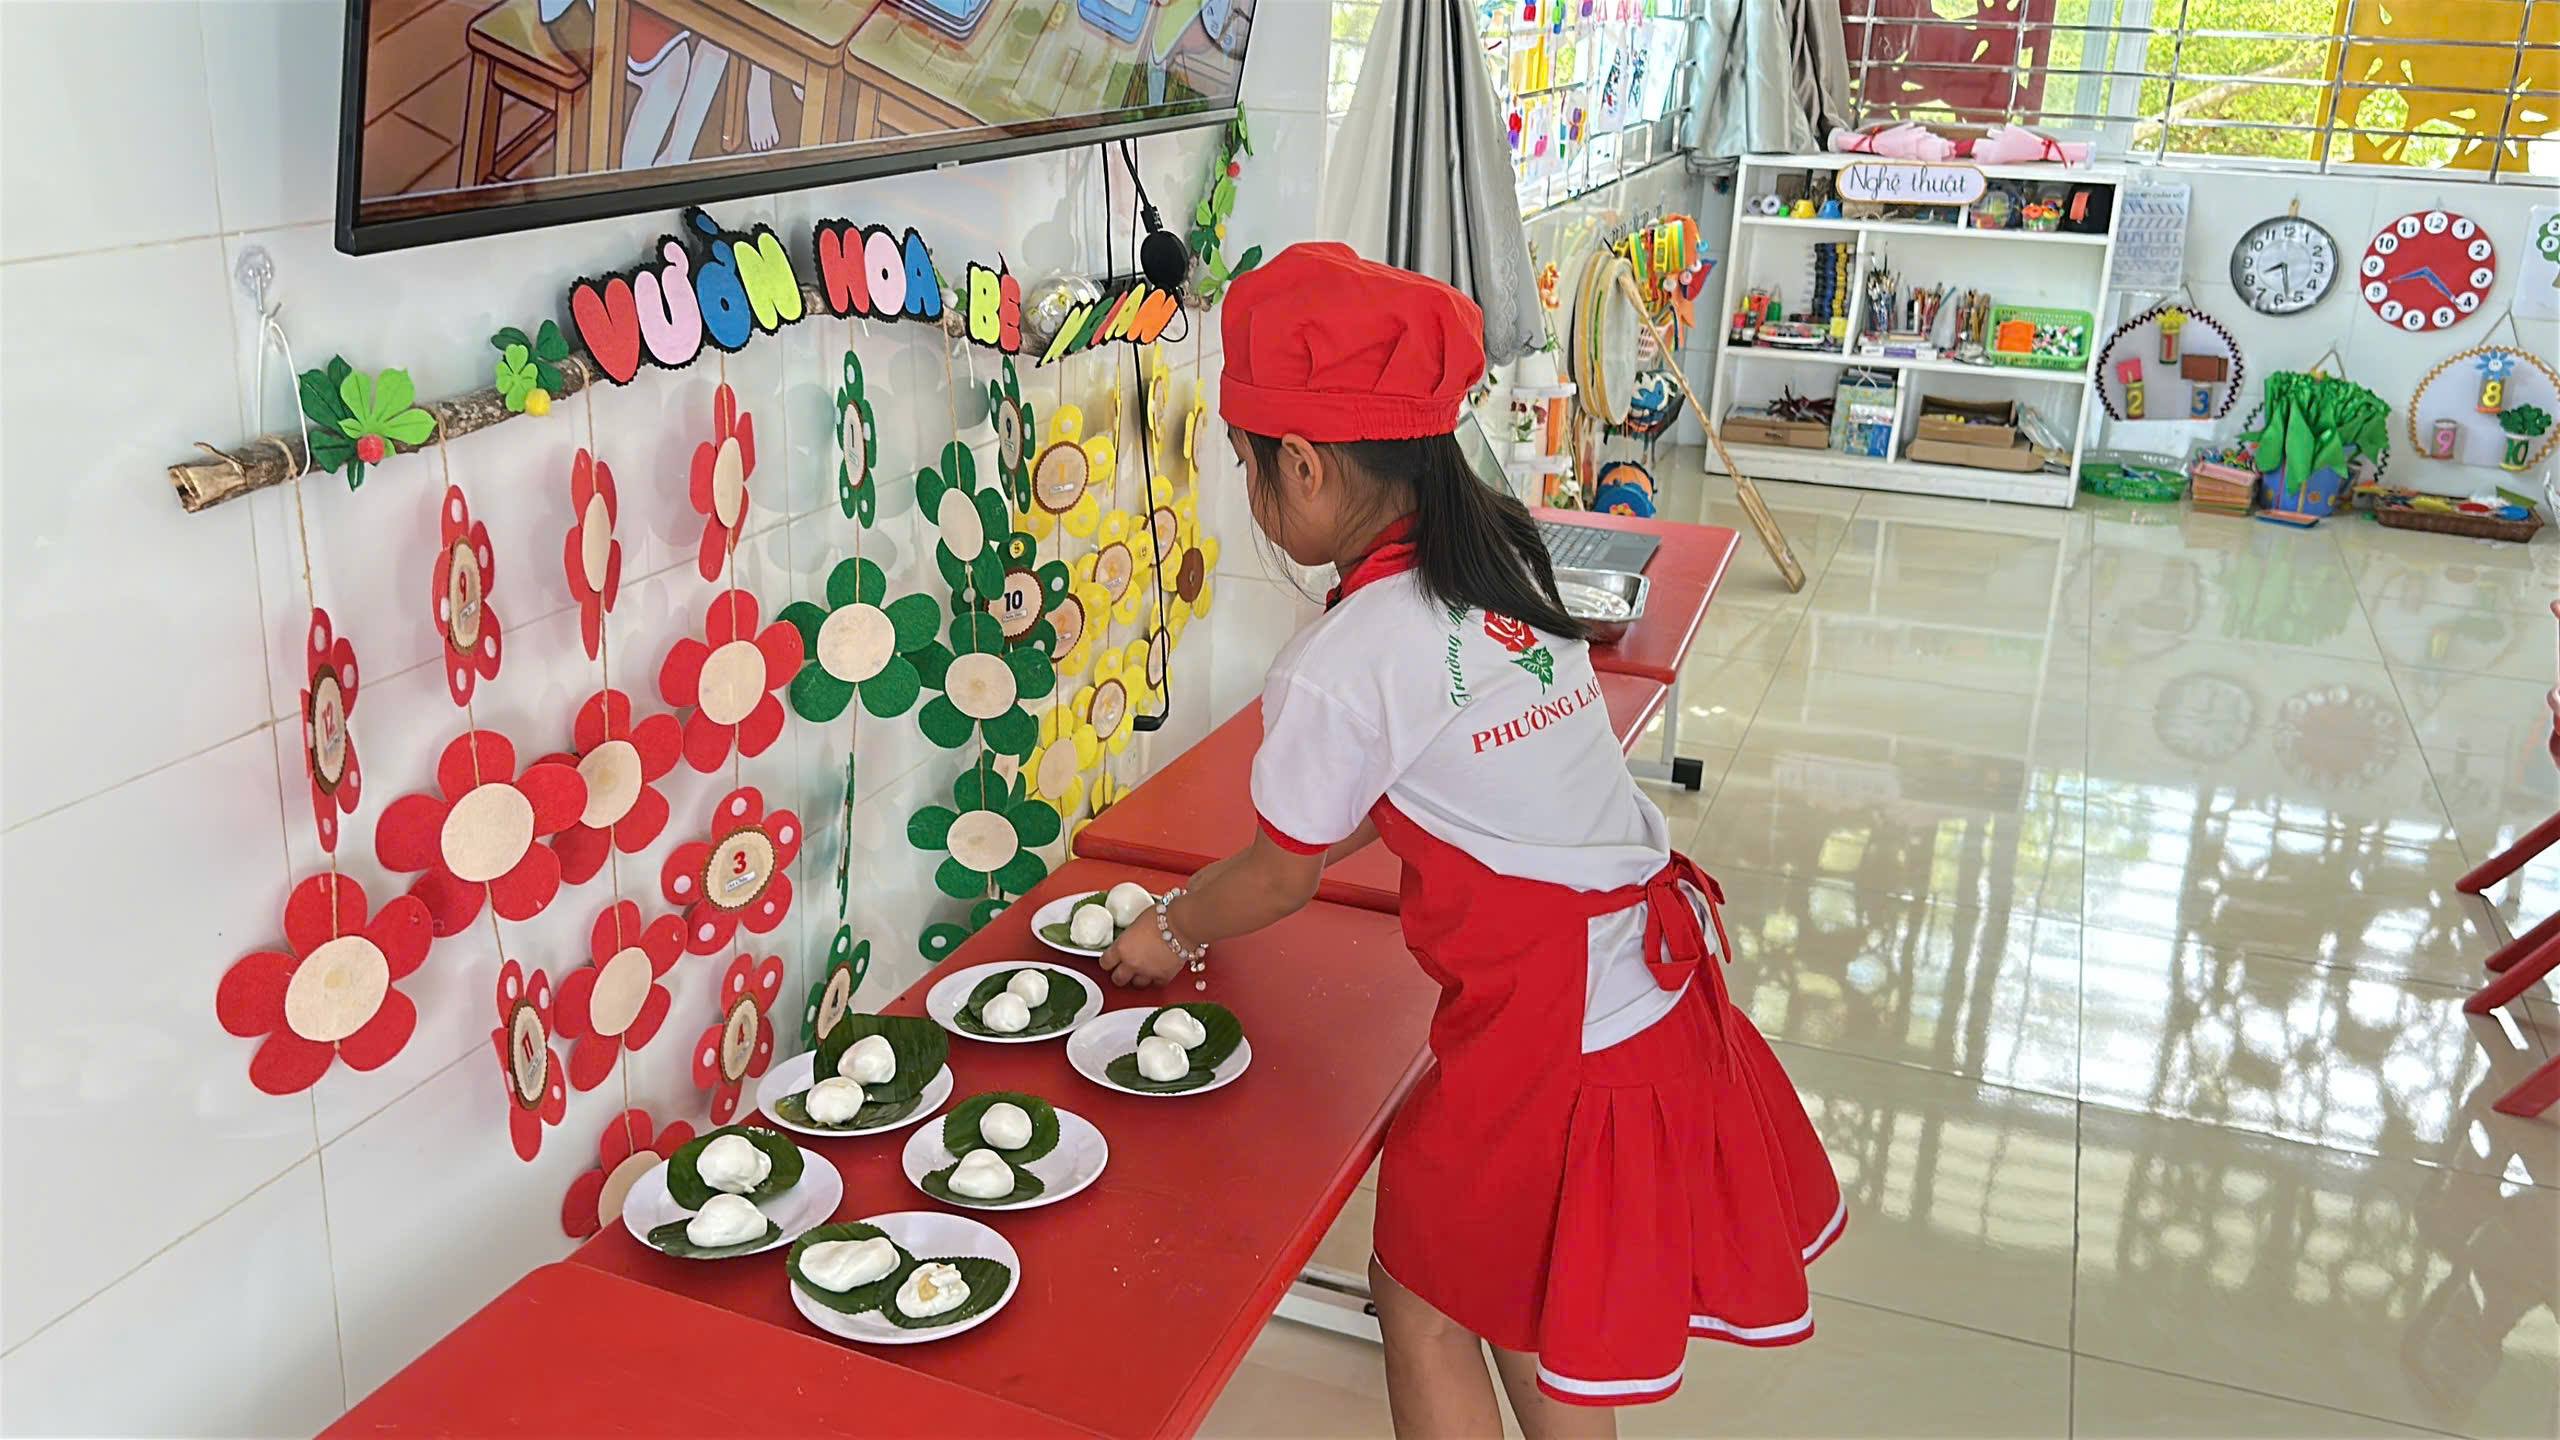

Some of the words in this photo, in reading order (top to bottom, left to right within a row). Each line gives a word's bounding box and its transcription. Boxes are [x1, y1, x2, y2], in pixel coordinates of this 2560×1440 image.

[1849, 164, 1901, 200] Nghệ
[1910, 164, 1967, 198] thuật
[2401, 222, 2415, 234] 11
[2429, 216, 2444, 229] 12
[2461, 222, 2467, 235] 1
[2266, 228, 2276, 240] 11
[2284, 225, 2296, 238] 12
[2305, 232, 2310, 244] 1
[2250, 240, 2264, 251] 10
[2379, 237, 2394, 250] 10
[2312, 245, 2323, 257] 2
[2474, 244, 2484, 257] 2
[2243, 256, 2254, 269] 9
[2313, 261, 2324, 274] 3
[2369, 260, 2378, 272] 9
[2243, 274, 2255, 287] 8
[2306, 278, 2317, 290] 4
[2476, 272, 2488, 284] 3
[570, 208, 804, 384] VƯỜN
[815, 221, 943, 321] HOA
[2256, 288, 2267, 301] 7
[2292, 290, 2304, 303] 5
[2372, 286, 2380, 298] 8
[2274, 293, 2284, 306] 6
[2463, 296, 2472, 308] 4
[2387, 305, 2396, 317] 7
[2439, 311, 2448, 324] 5
[2409, 314, 2418, 326] 6
[2165, 334, 2173, 360] 1
[2482, 380, 2502, 407] 8
[2126, 390, 2143, 418] 2
[2191, 389, 2209, 416] 3
[1005, 416, 1012, 439] 9
[2436, 429, 2456, 456] 9
[2505, 438, 2529, 466] 10
[459, 571, 467, 602] 9
[1003, 589, 1023, 612] 10
[322, 701, 336, 741] 12
[1471, 695, 1574, 754] PHƯỜNG
[733, 850, 747, 875] 3
[521, 1031, 535, 1063] 11
